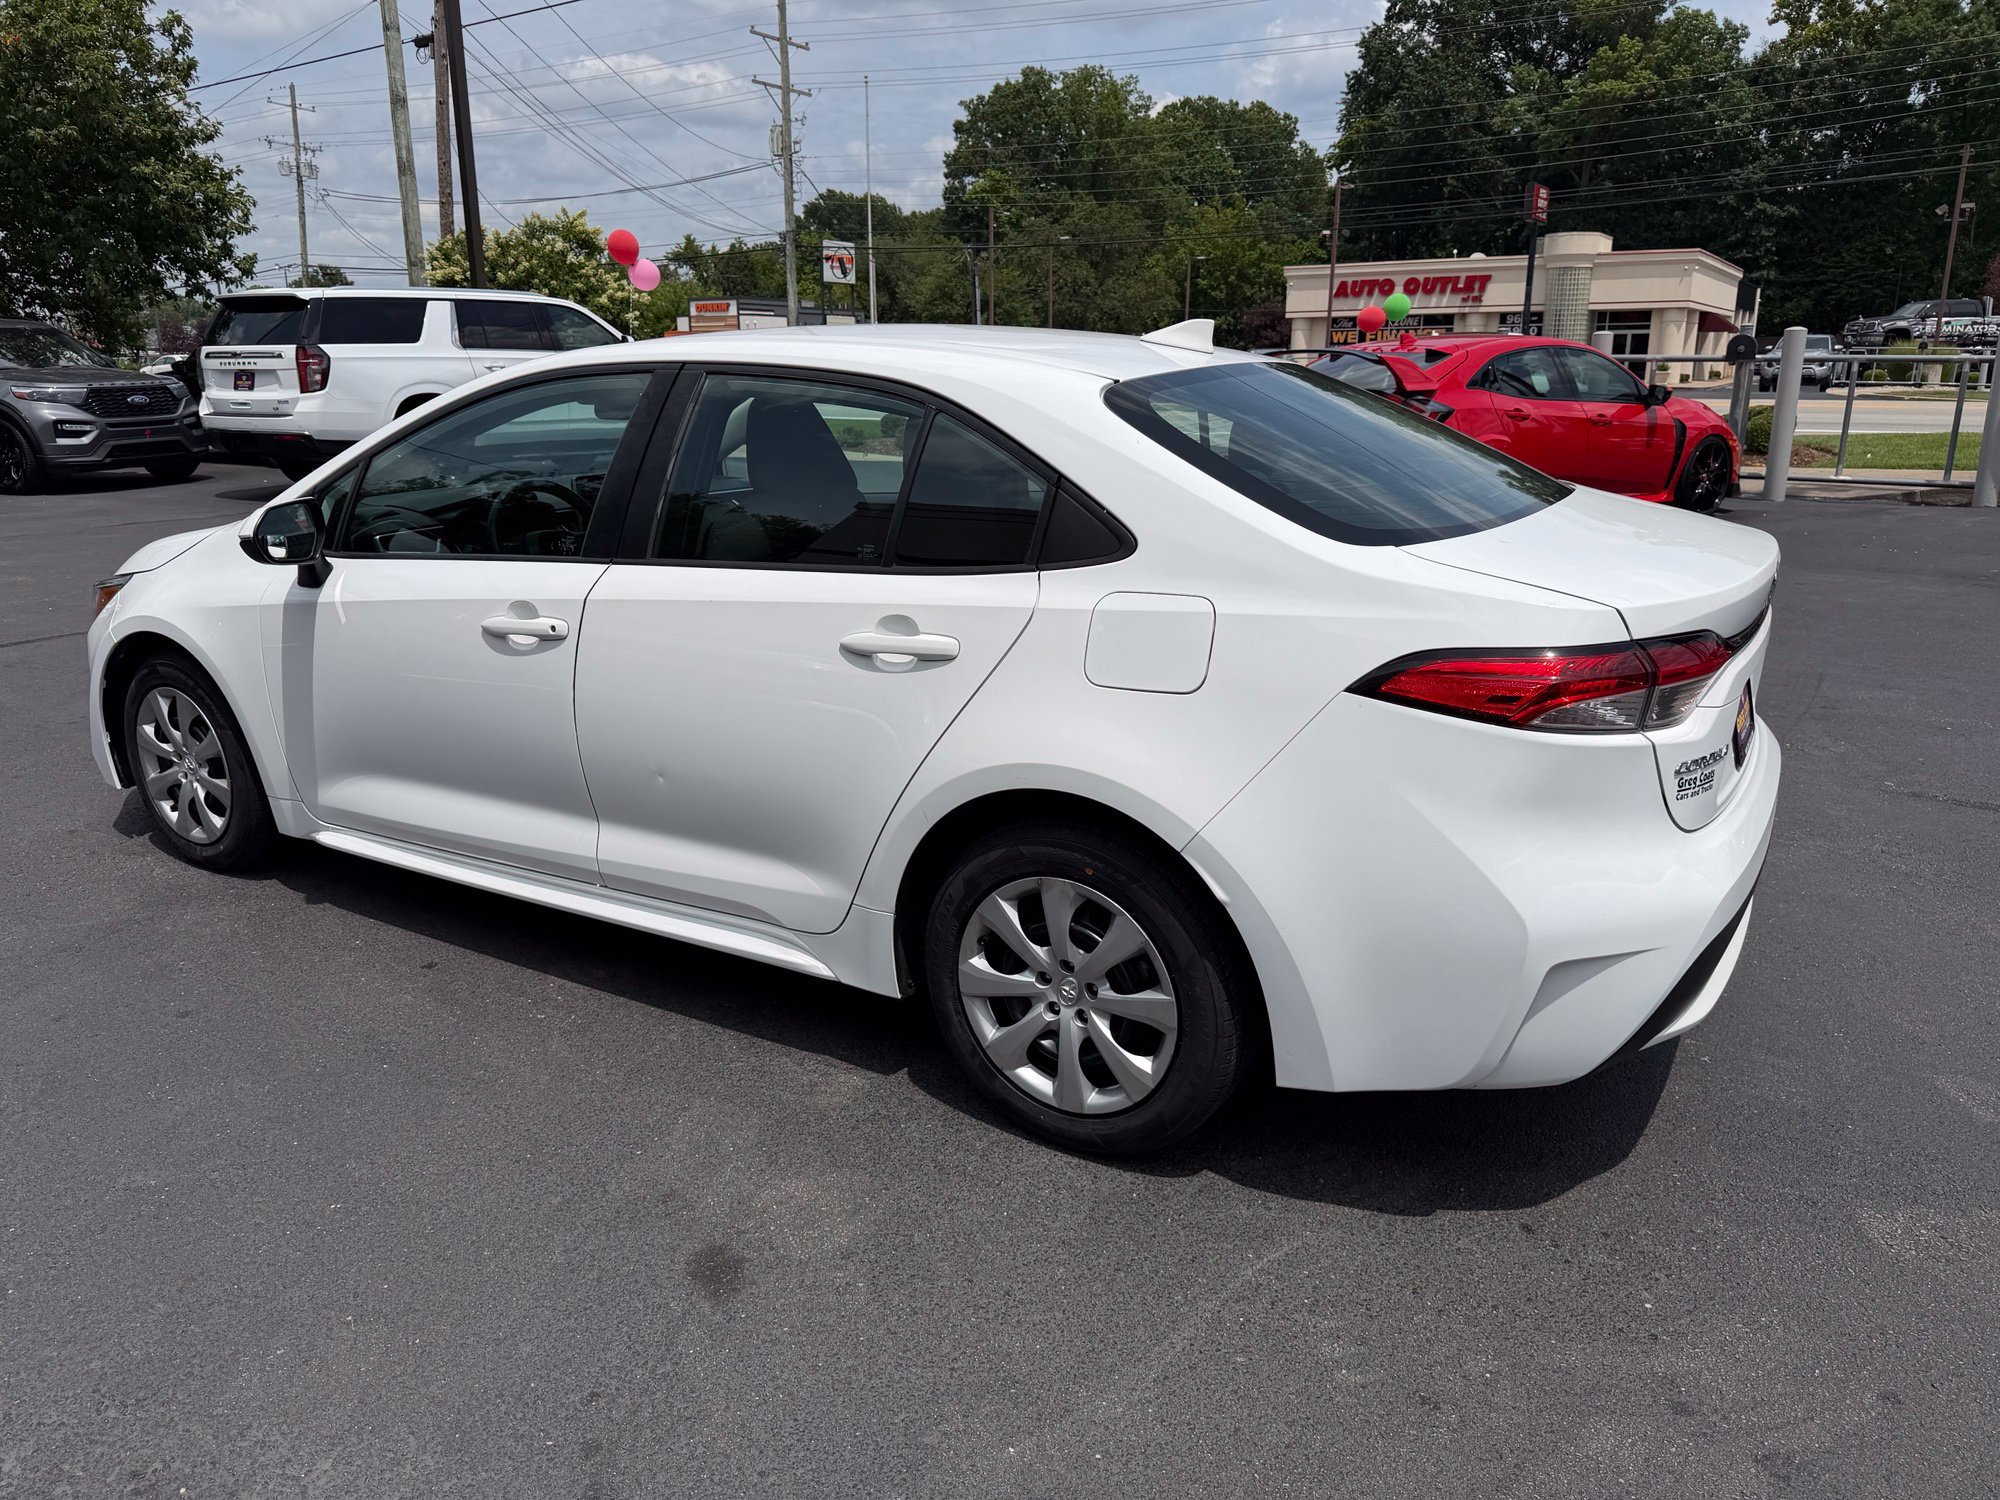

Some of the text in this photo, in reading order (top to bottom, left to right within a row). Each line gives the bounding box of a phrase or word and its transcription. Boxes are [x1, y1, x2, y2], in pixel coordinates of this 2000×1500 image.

[1334, 275, 1492, 297] AUTO OUTLET
[1333, 318, 1353, 328] The
[1331, 331, 1357, 343] WE
[1677, 776, 1698, 790] Greg
[1675, 792, 1690, 801] Cars
[1690, 788, 1701, 798] and
